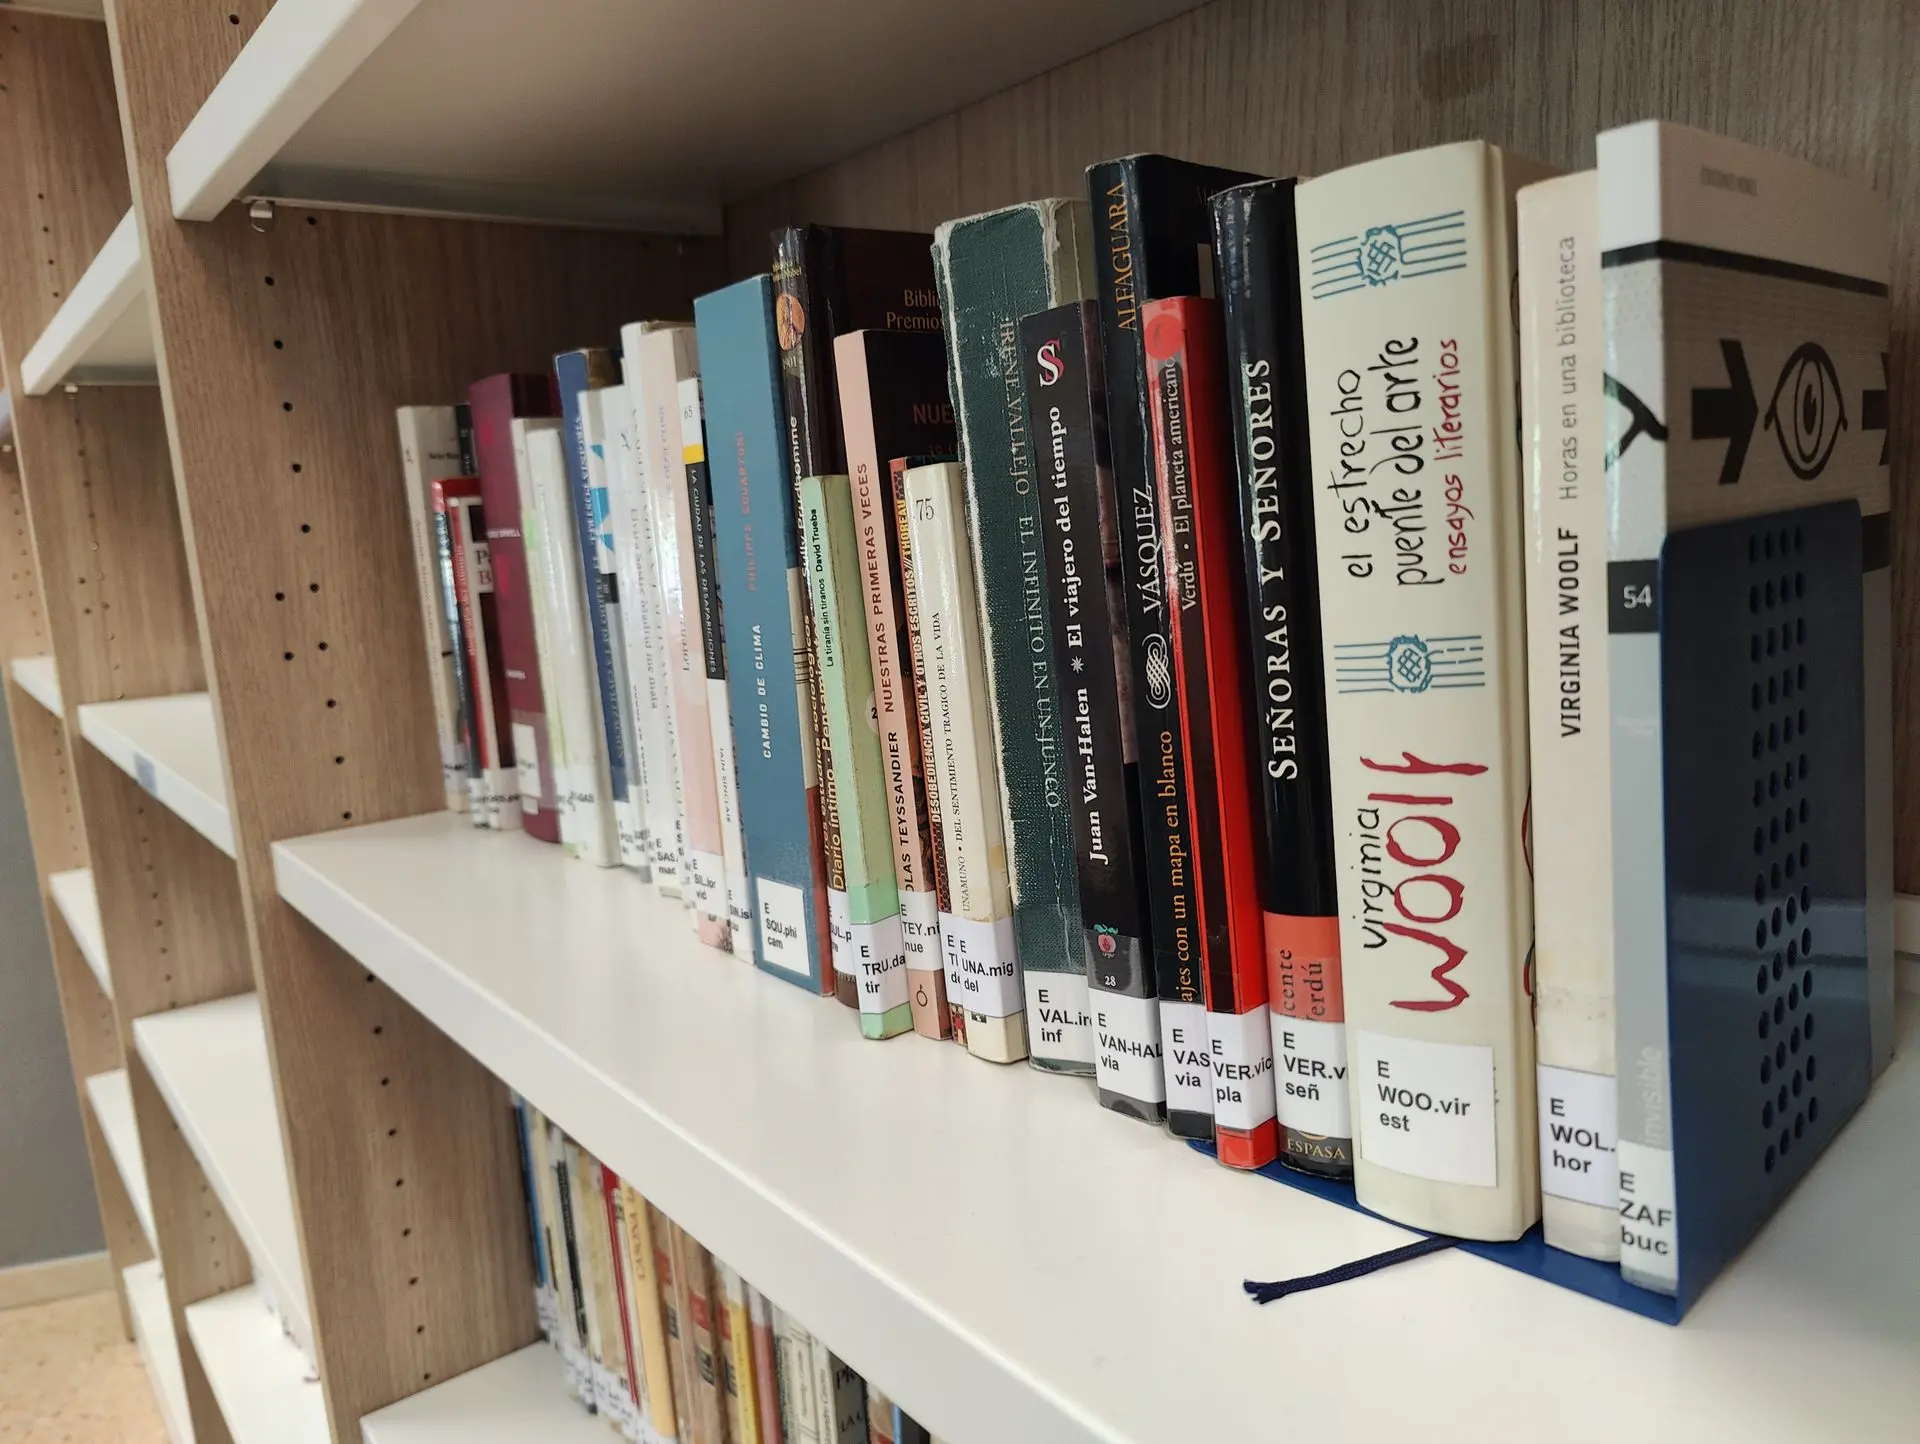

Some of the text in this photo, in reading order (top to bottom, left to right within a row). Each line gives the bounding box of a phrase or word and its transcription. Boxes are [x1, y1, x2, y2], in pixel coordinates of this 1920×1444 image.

[1106, 181, 1137, 332] ALFAGUARA
[904, 289, 940, 308] Bibli
[1556, 235, 1579, 501] Horas en una biblioteca
[1367, 337, 1446, 586] puente del arte
[1432, 338, 1475, 575] ensayos literarios
[1162, 356, 1198, 612] Verdú El planeta americano
[1327, 369, 1374, 578] el estrecho
[916, 498, 935, 521] 75
[810, 508, 821, 543] Trueba
[812, 543, 823, 572] David
[1133, 484, 1161, 615] VÁSQUEZ
[999, 320, 1062, 808] IRENE VALLEJO EL INFINITO EN UN JUNCO
[1245, 359, 1299, 780] SEÑORAS Y SEÑORES
[693, 488, 703, 532] CIUDAD
[701, 577, 717, 673] DESAPARICIONES
[857, 463, 895, 713] NUESTRAS PRIMERAS VECES
[817, 578, 827, 612] tiranos
[1623, 585, 1653, 609] 54
[823, 626, 832, 658] tiranía
[1050, 406, 1109, 865] Juan Van-Halen El viajero del tiempo
[1557, 527, 1581, 738] VIRGINIA WOOLF
[826, 657, 834, 668] La
[910, 636, 926, 675] OTROS
[752, 624, 772, 759] CAMBIO DE CLIMA
[916, 677, 926, 691] Y
[918, 689, 930, 724] CIVIL
[923, 724, 941, 824] DESOBEDIENCIA
[932, 612, 970, 912] UNAMUNO DEL SENTIMIENTO TRAGICO DE LA VIDA
[1157, 730, 1176, 798] blanco
[887, 731, 909, 846] TEYSSANDIER
[1165, 803, 1180, 828] en
[825, 769, 845, 890] Diario íntimo
[1168, 834, 1187, 888] mapa
[1349, 808, 1395, 948] virginia
[764, 902, 770, 914] E
[901, 904, 907, 917] E
[1173, 894, 1187, 920] un
[767, 934, 784, 950] cam
[861, 945, 870, 958] E
[904, 941, 924, 954] nue
[948, 934, 955, 948] E
[960, 939, 967, 953] E
[1175, 926, 1190, 962] con
[962, 957, 1014, 977] UNA.mig
[865, 981, 881, 994] tir
[964, 978, 979, 993] del
[1104, 974, 1117, 987] 28
[1038, 989, 1050, 1003] E
[1097, 1012, 1107, 1028] E
[1041, 1029, 1063, 1043] inf
[1099, 1032, 1162, 1058] VAN-HAL
[1173, 1028, 1184, 1043] E
[1212, 1040, 1223, 1055] E
[1283, 1031, 1295, 1049] E
[1101, 1055, 1120, 1071] via
[1173, 1050, 1211, 1067] VAS
[1213, 1057, 1273, 1080] VER.vic
[1377, 1060, 1391, 1079] E
[1175, 1073, 1201, 1088] via
[1285, 1082, 1320, 1101] señ
[1216, 1086, 1242, 1103] pla
[1378, 1083, 1471, 1117] WOO.vir
[1550, 1097, 1566, 1117] E
[1380, 1112, 1411, 1132] est
[1287, 1138, 1346, 1160] ESPASA
[1550, 1122, 1616, 1153] WOL.
[1553, 1150, 1592, 1174] hor
[1619, 1171, 1636, 1194] E
[1620, 1199, 1673, 1229] ZAF
[1620, 1225, 1669, 1257] buc
